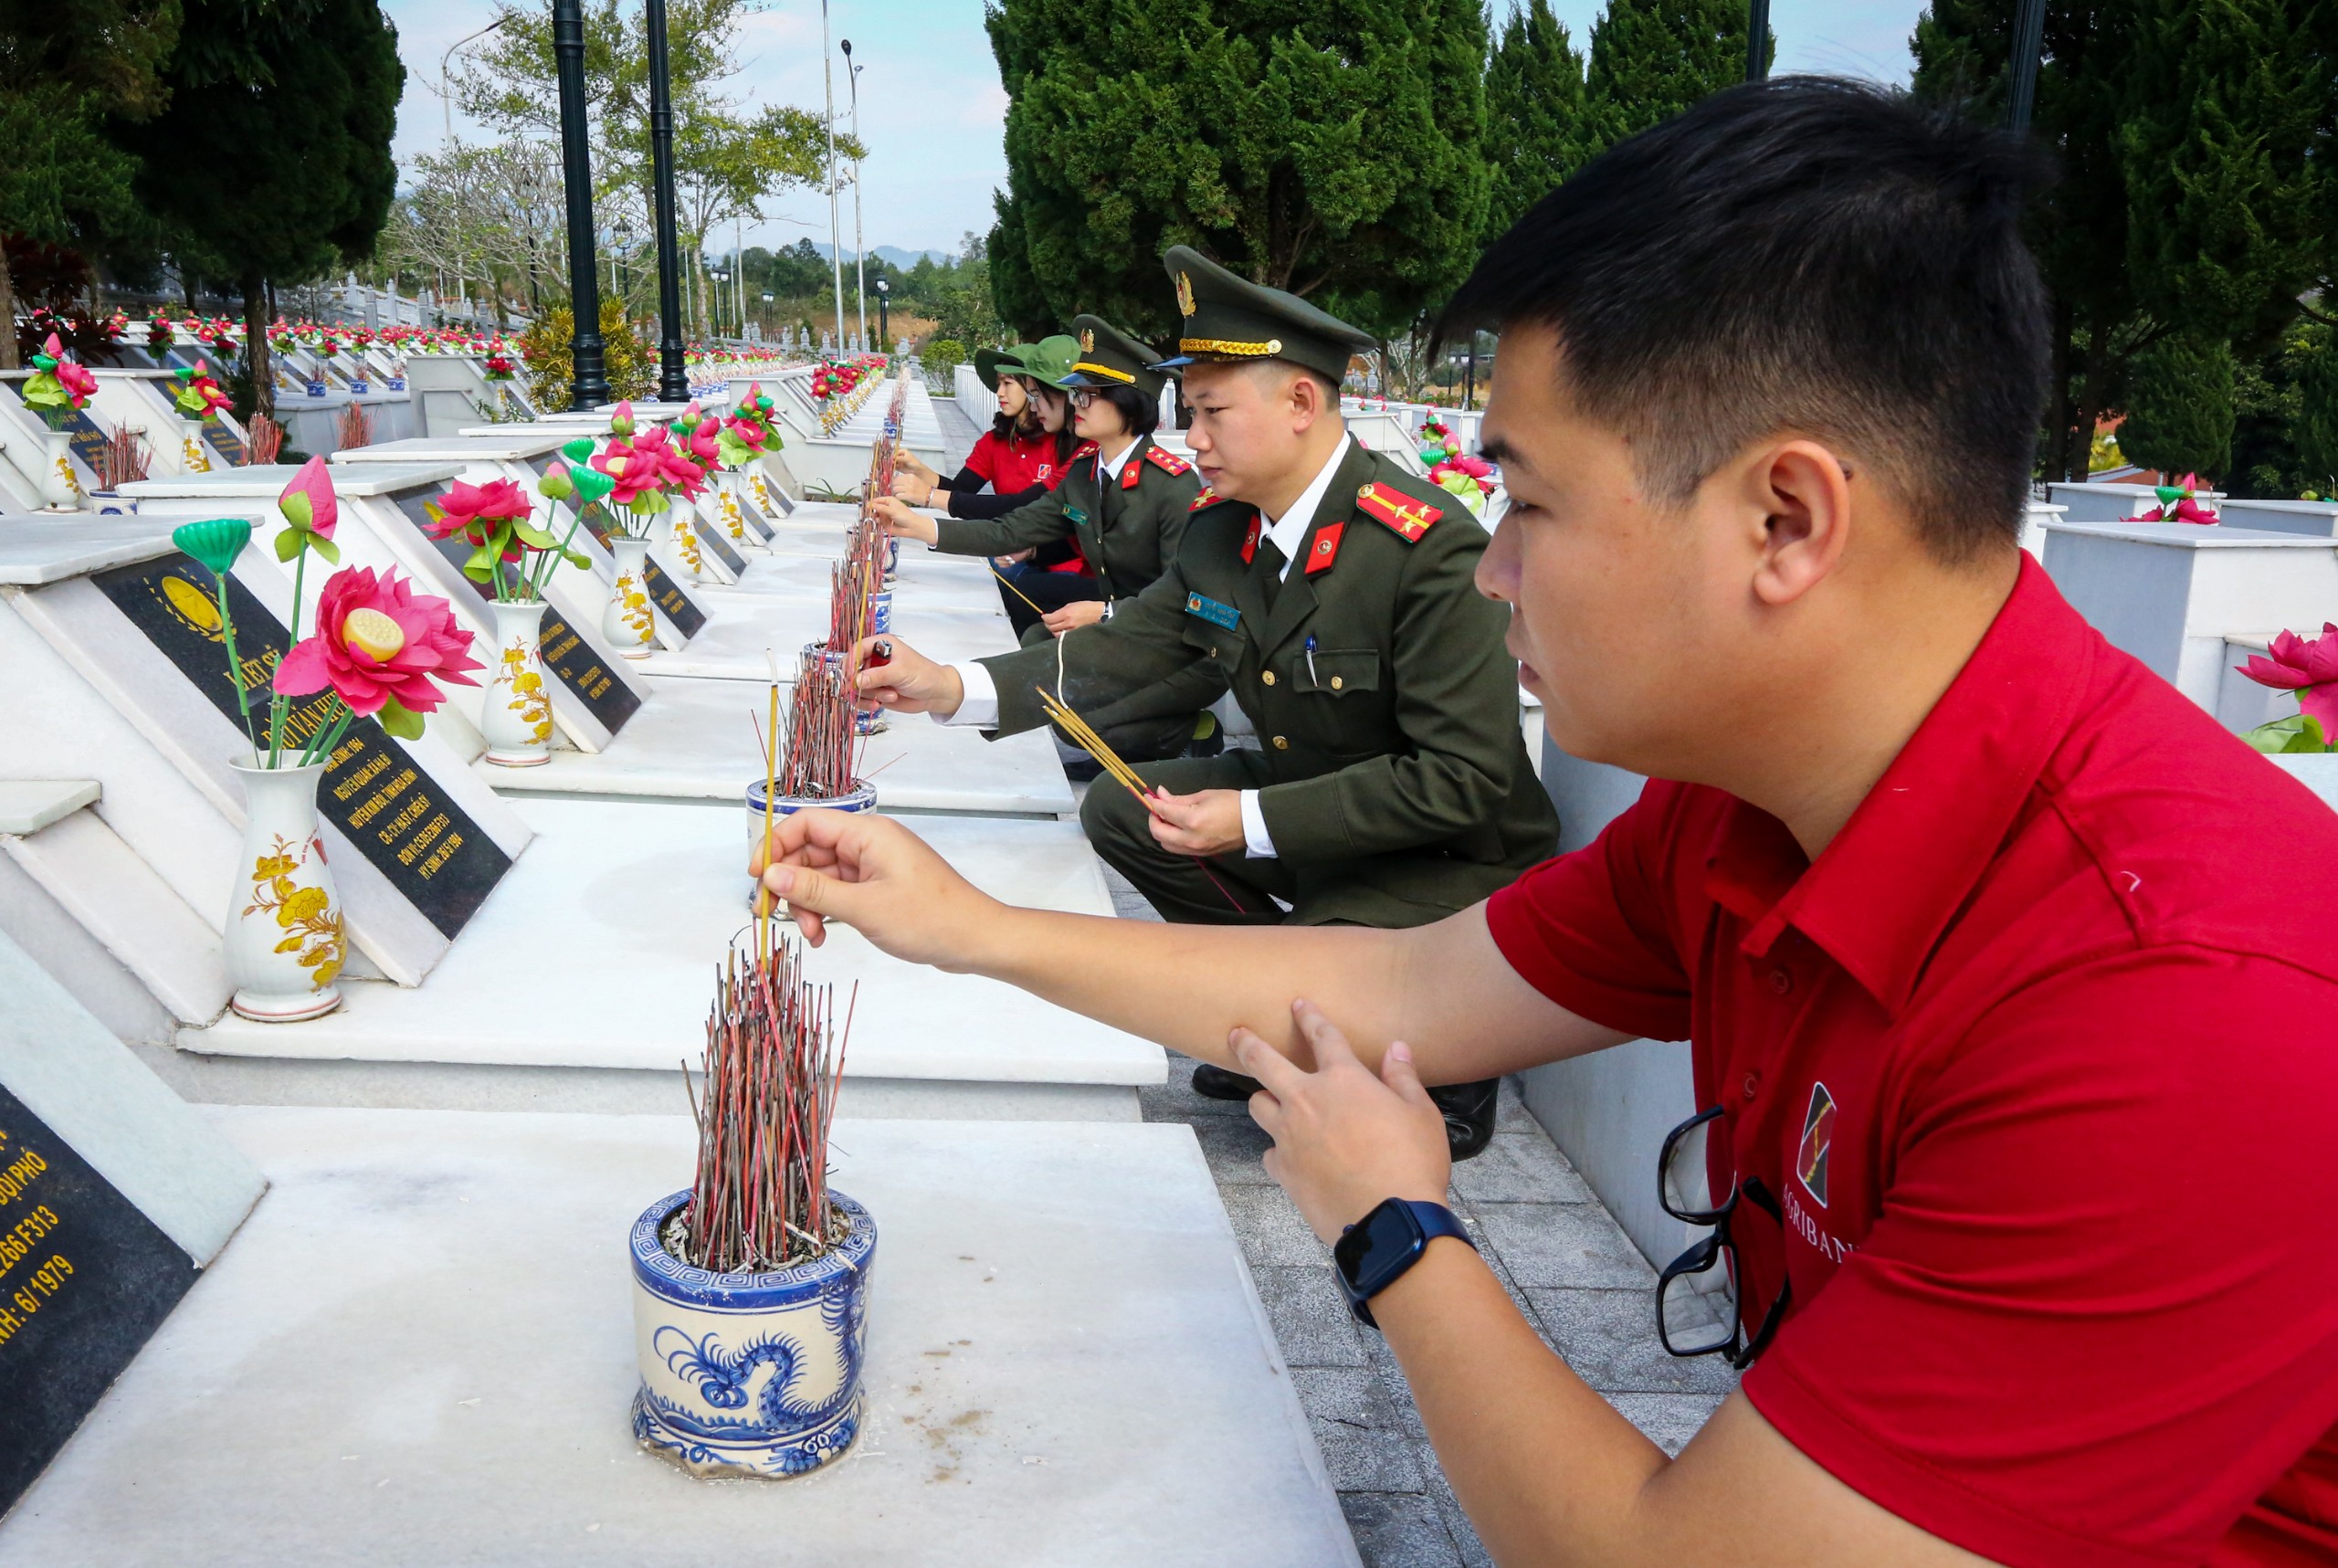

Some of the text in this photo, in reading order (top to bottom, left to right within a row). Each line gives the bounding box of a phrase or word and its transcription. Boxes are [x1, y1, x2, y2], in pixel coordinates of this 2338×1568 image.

[286, 704, 322, 737] VĂN
[8, 1146, 47, 1185] PHÓ
[1783, 1183, 1859, 1264] AGRIBAN
